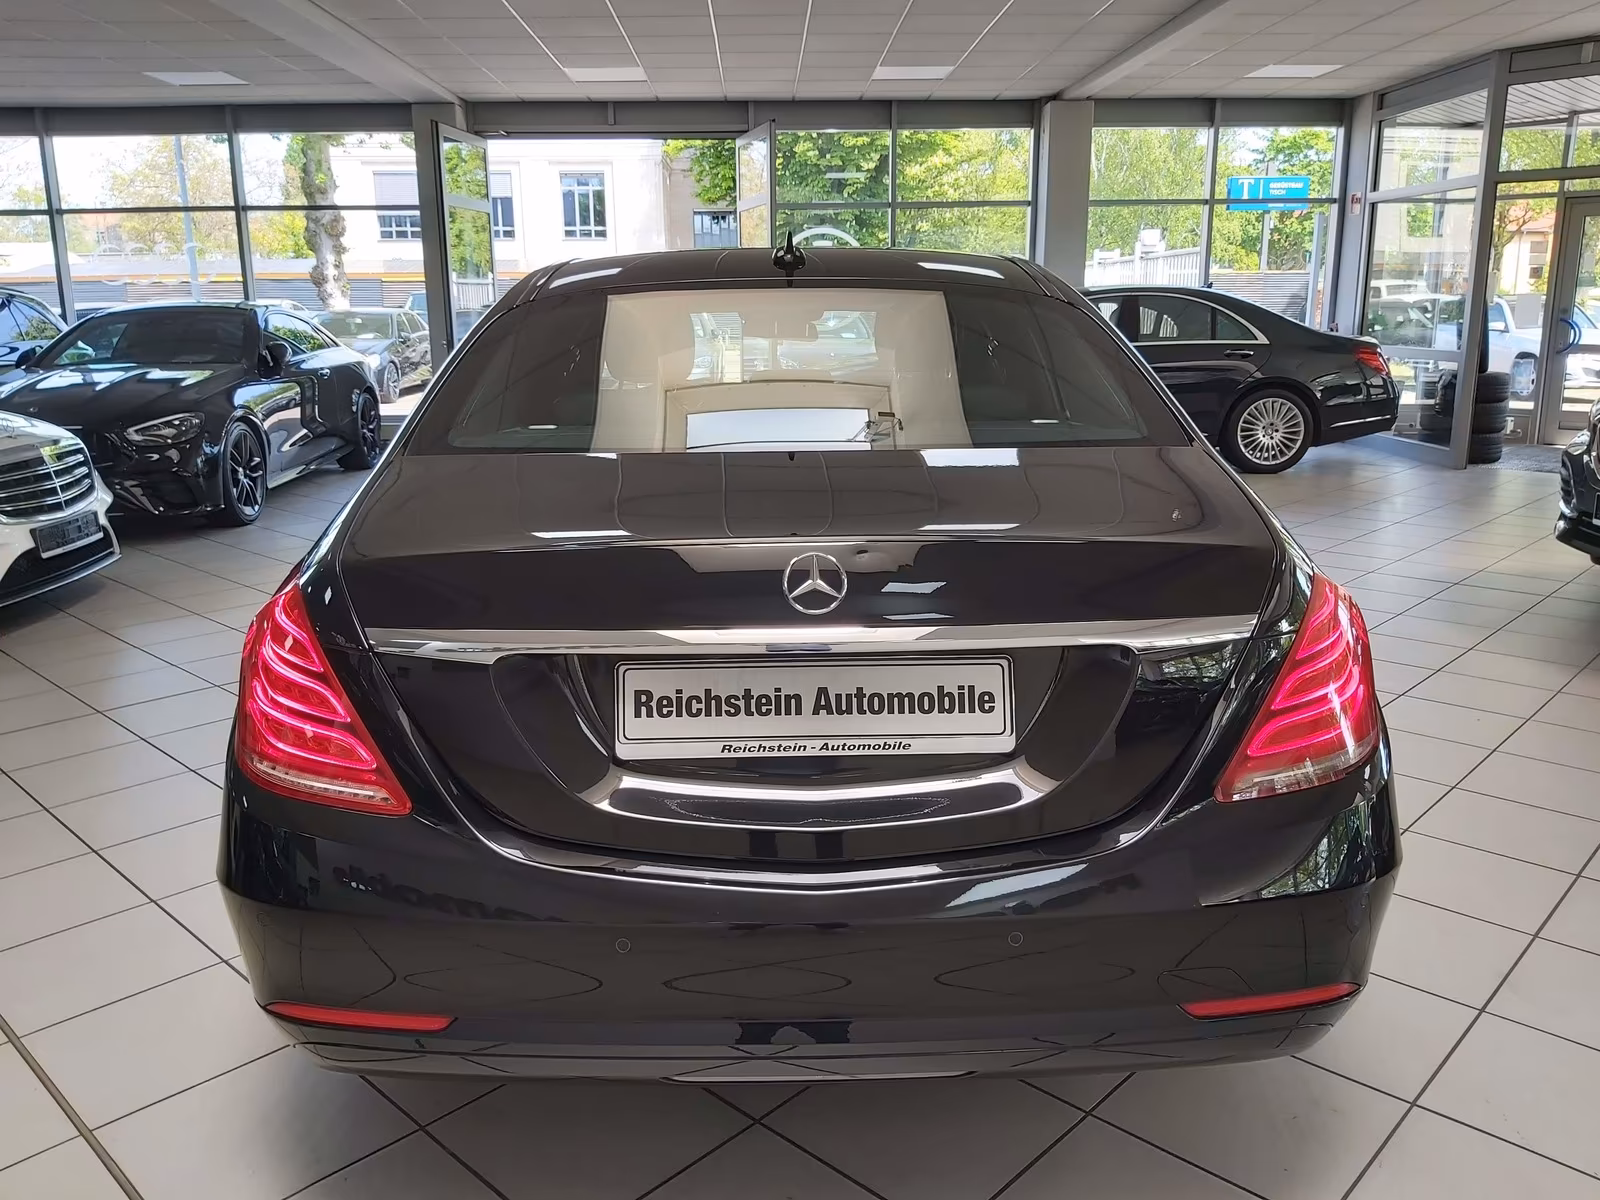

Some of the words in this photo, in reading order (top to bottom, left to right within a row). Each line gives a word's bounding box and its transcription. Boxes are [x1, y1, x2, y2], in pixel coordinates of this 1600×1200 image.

[633, 687, 803, 719] Reichstein
[811, 684, 996, 716] Automobile
[720, 742, 808, 754] Reichstein
[818, 741, 912, 752] Automobile
